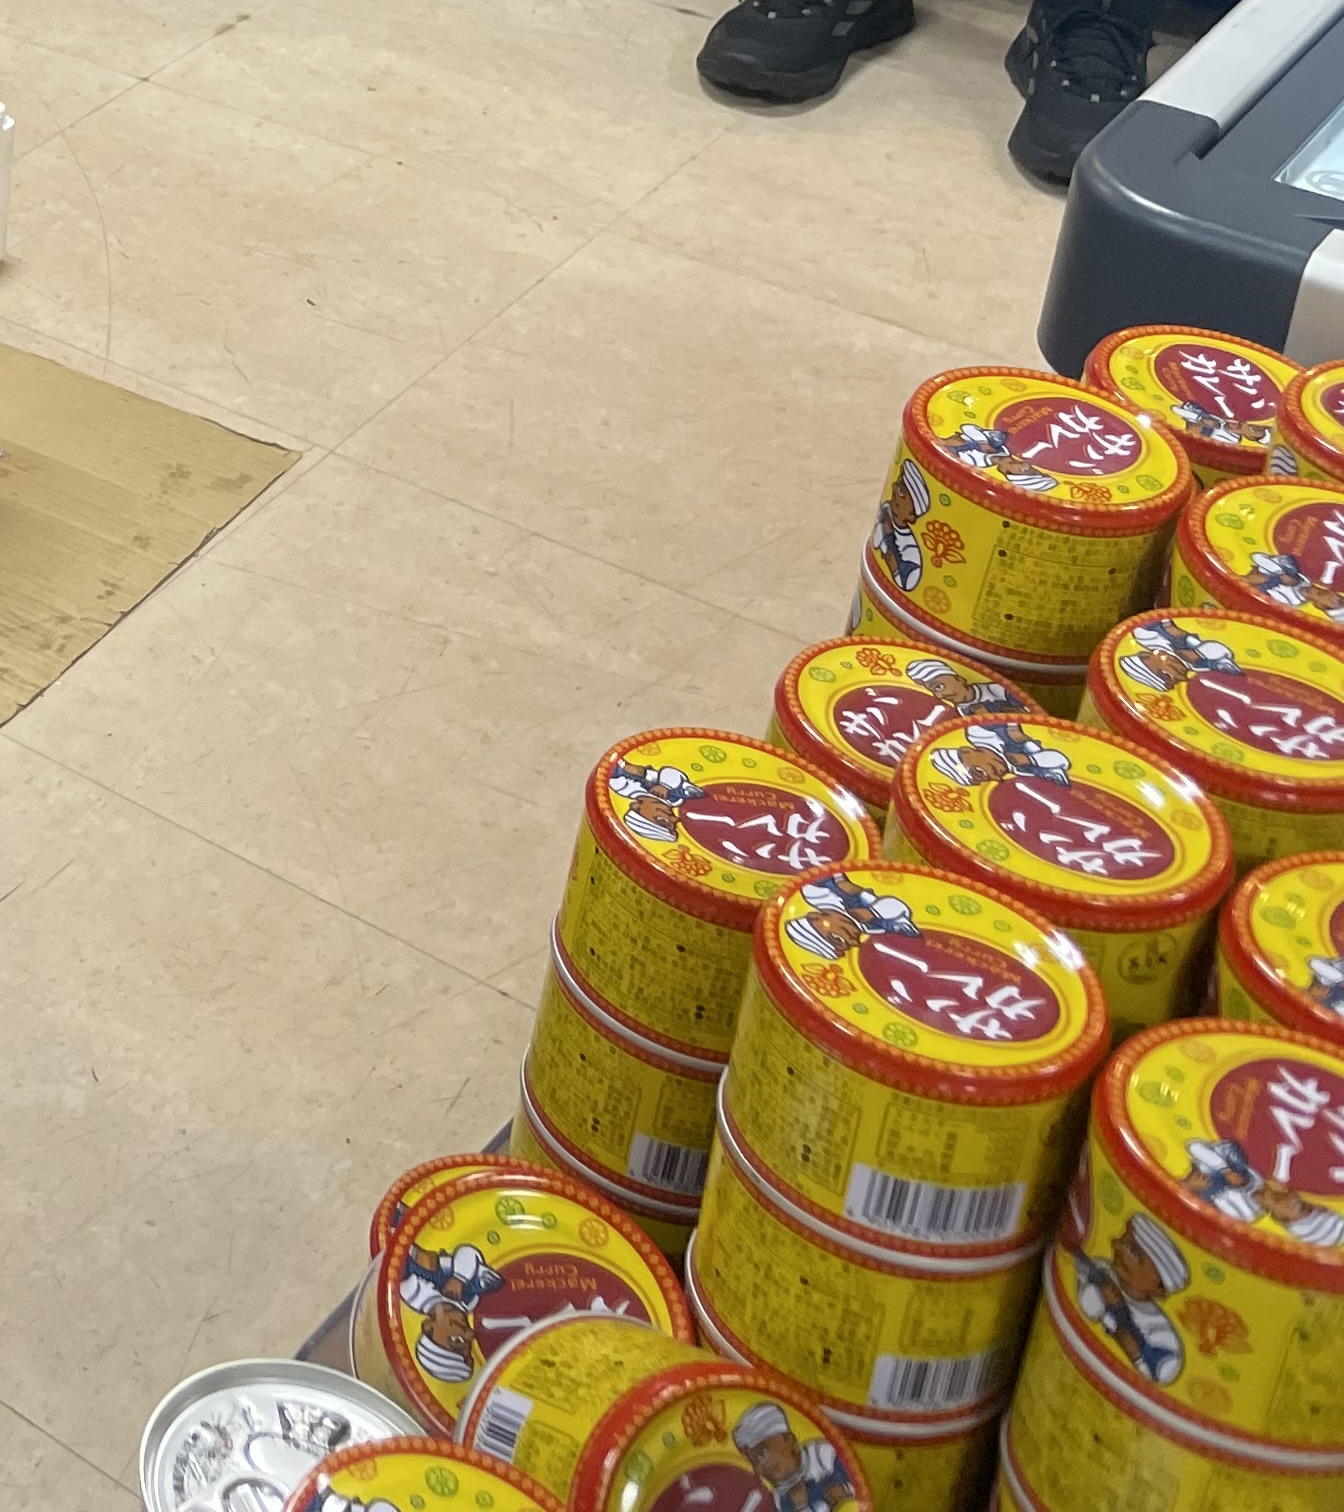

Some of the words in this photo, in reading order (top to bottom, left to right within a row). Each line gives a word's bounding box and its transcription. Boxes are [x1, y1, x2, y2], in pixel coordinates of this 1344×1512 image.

[1021, 404, 1104, 459] カレー
[686, 811, 831, 844] カレー
[1015, 782, 1163, 867] カレー
[873, 942, 1046, 1021] カレー
